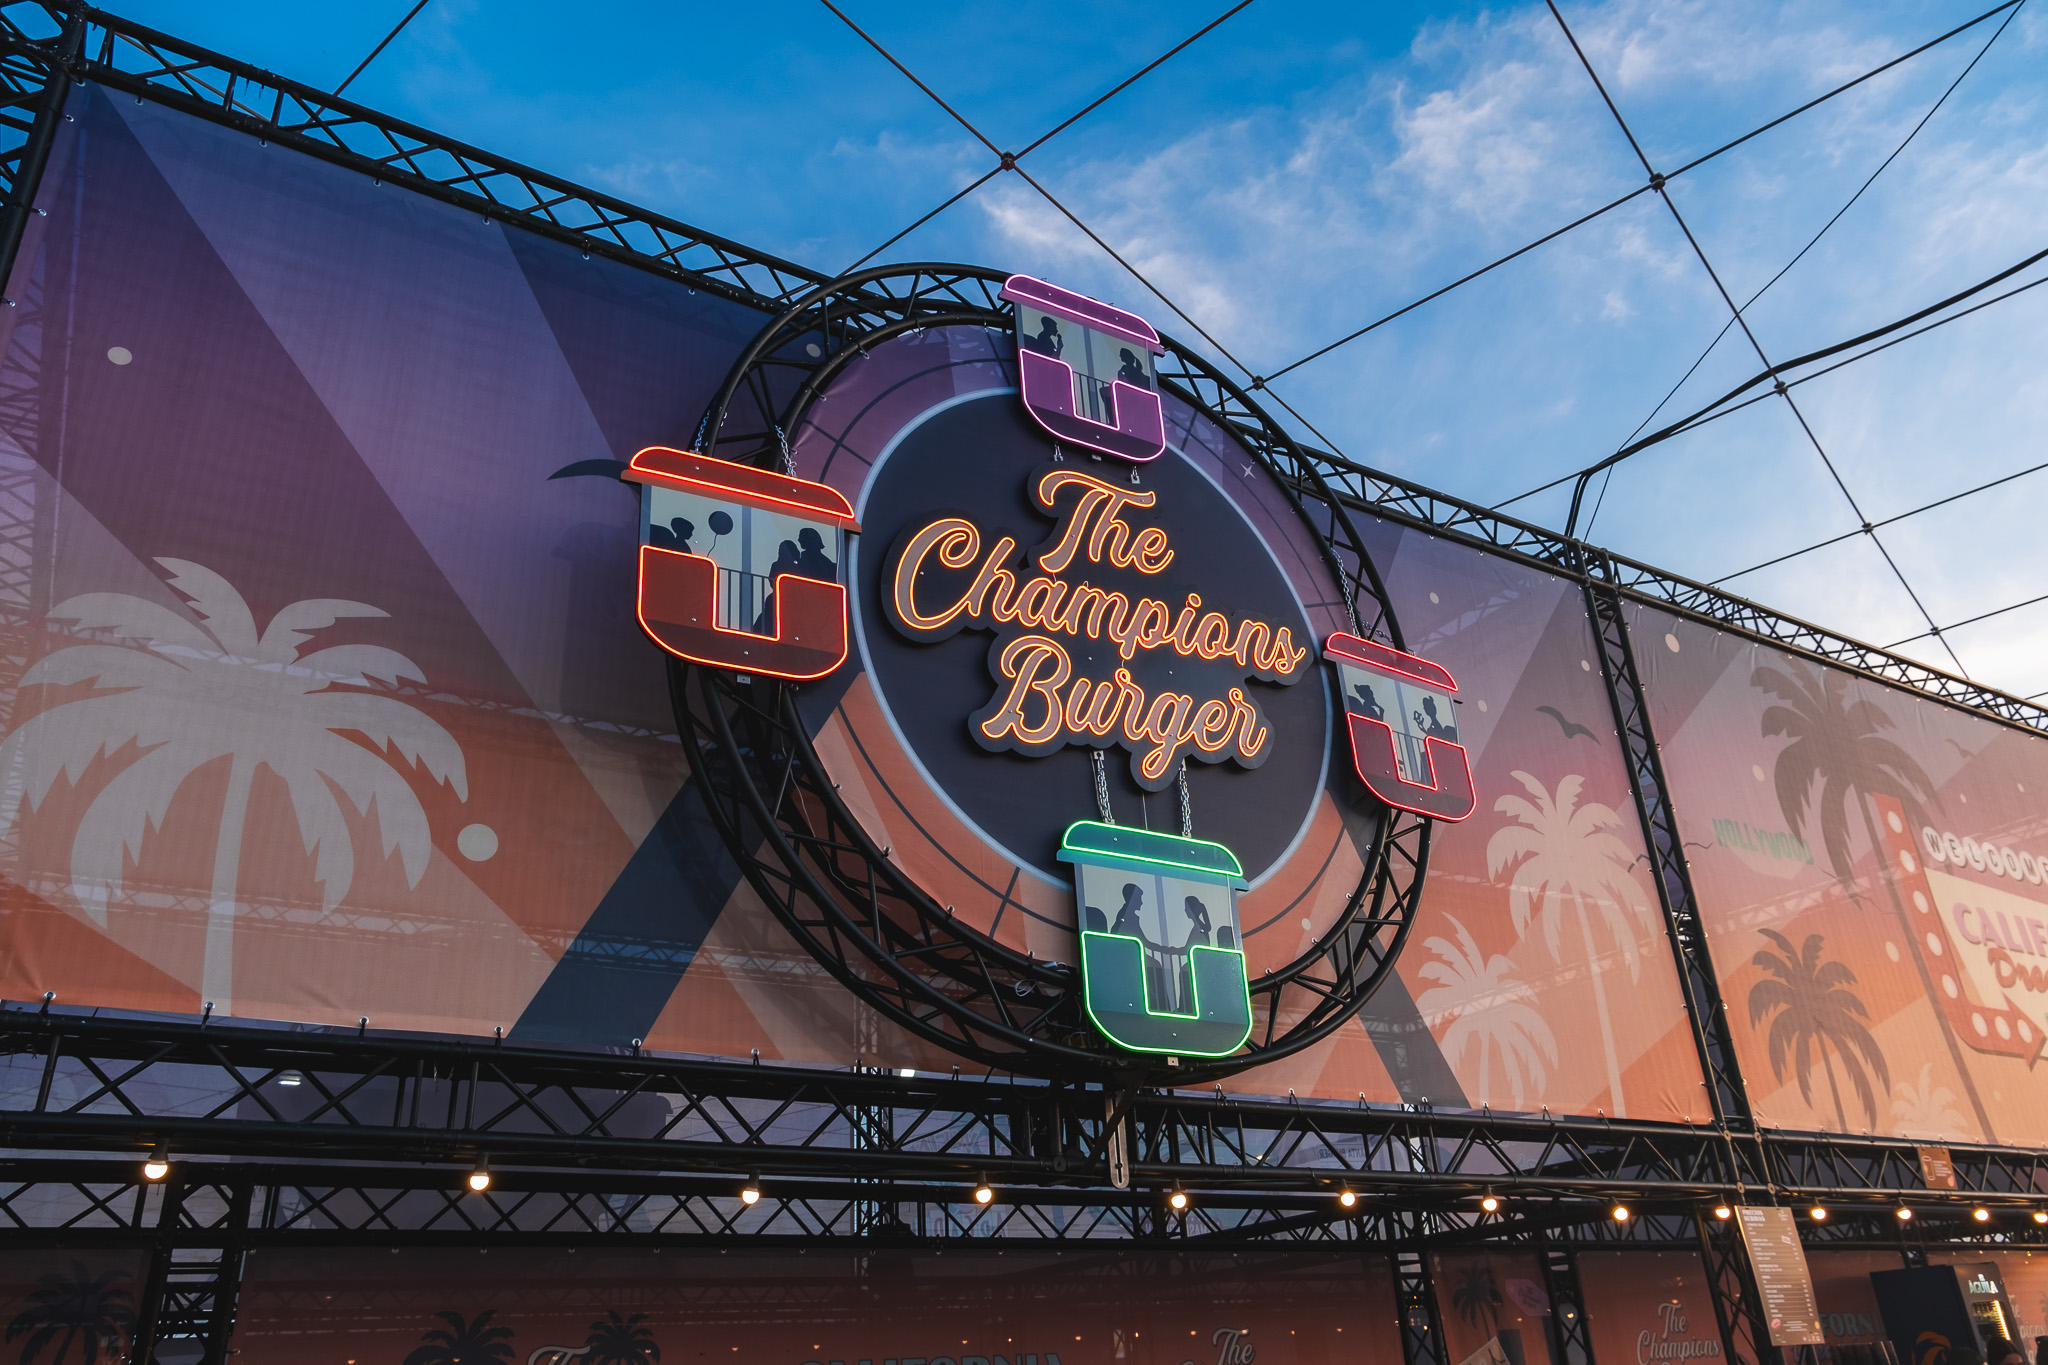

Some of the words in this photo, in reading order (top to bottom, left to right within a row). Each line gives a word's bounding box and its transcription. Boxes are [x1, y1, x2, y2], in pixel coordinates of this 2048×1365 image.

[1038, 469, 1174, 575] The
[894, 518, 1306, 675] Champions
[981, 635, 1267, 780] Burger
[1712, 818, 1814, 866] HOLLYWOOD
[1952, 903, 2048, 957] CALIF
[1211, 1327, 1256, 1365] The
[1658, 1303, 1688, 1339] The
[1636, 1329, 1720, 1365] Champions
